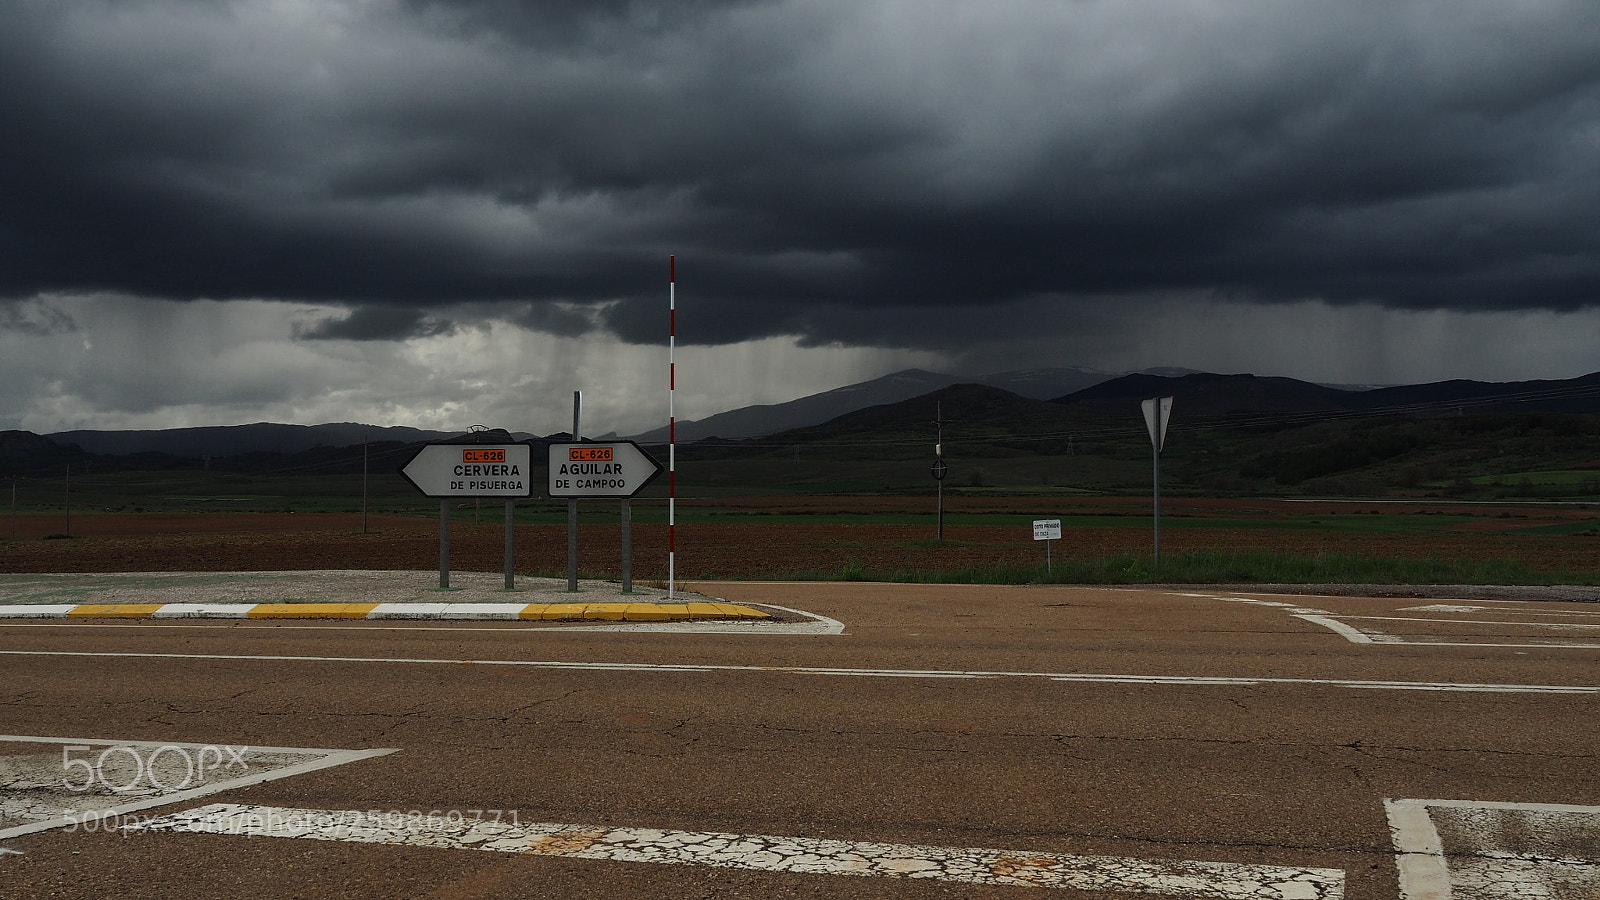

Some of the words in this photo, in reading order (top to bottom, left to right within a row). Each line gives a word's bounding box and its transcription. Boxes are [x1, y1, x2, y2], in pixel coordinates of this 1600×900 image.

[465, 452, 503, 460] CL-626
[571, 450, 610, 459] CL-626
[453, 465, 520, 476] CERVERA
[559, 463, 623, 475] AGUILAR
[450, 481, 464, 490] DE
[470, 481, 523, 490] PISUERGA
[555, 479, 570, 488] DE
[576, 479, 625, 488] CAMPOO
